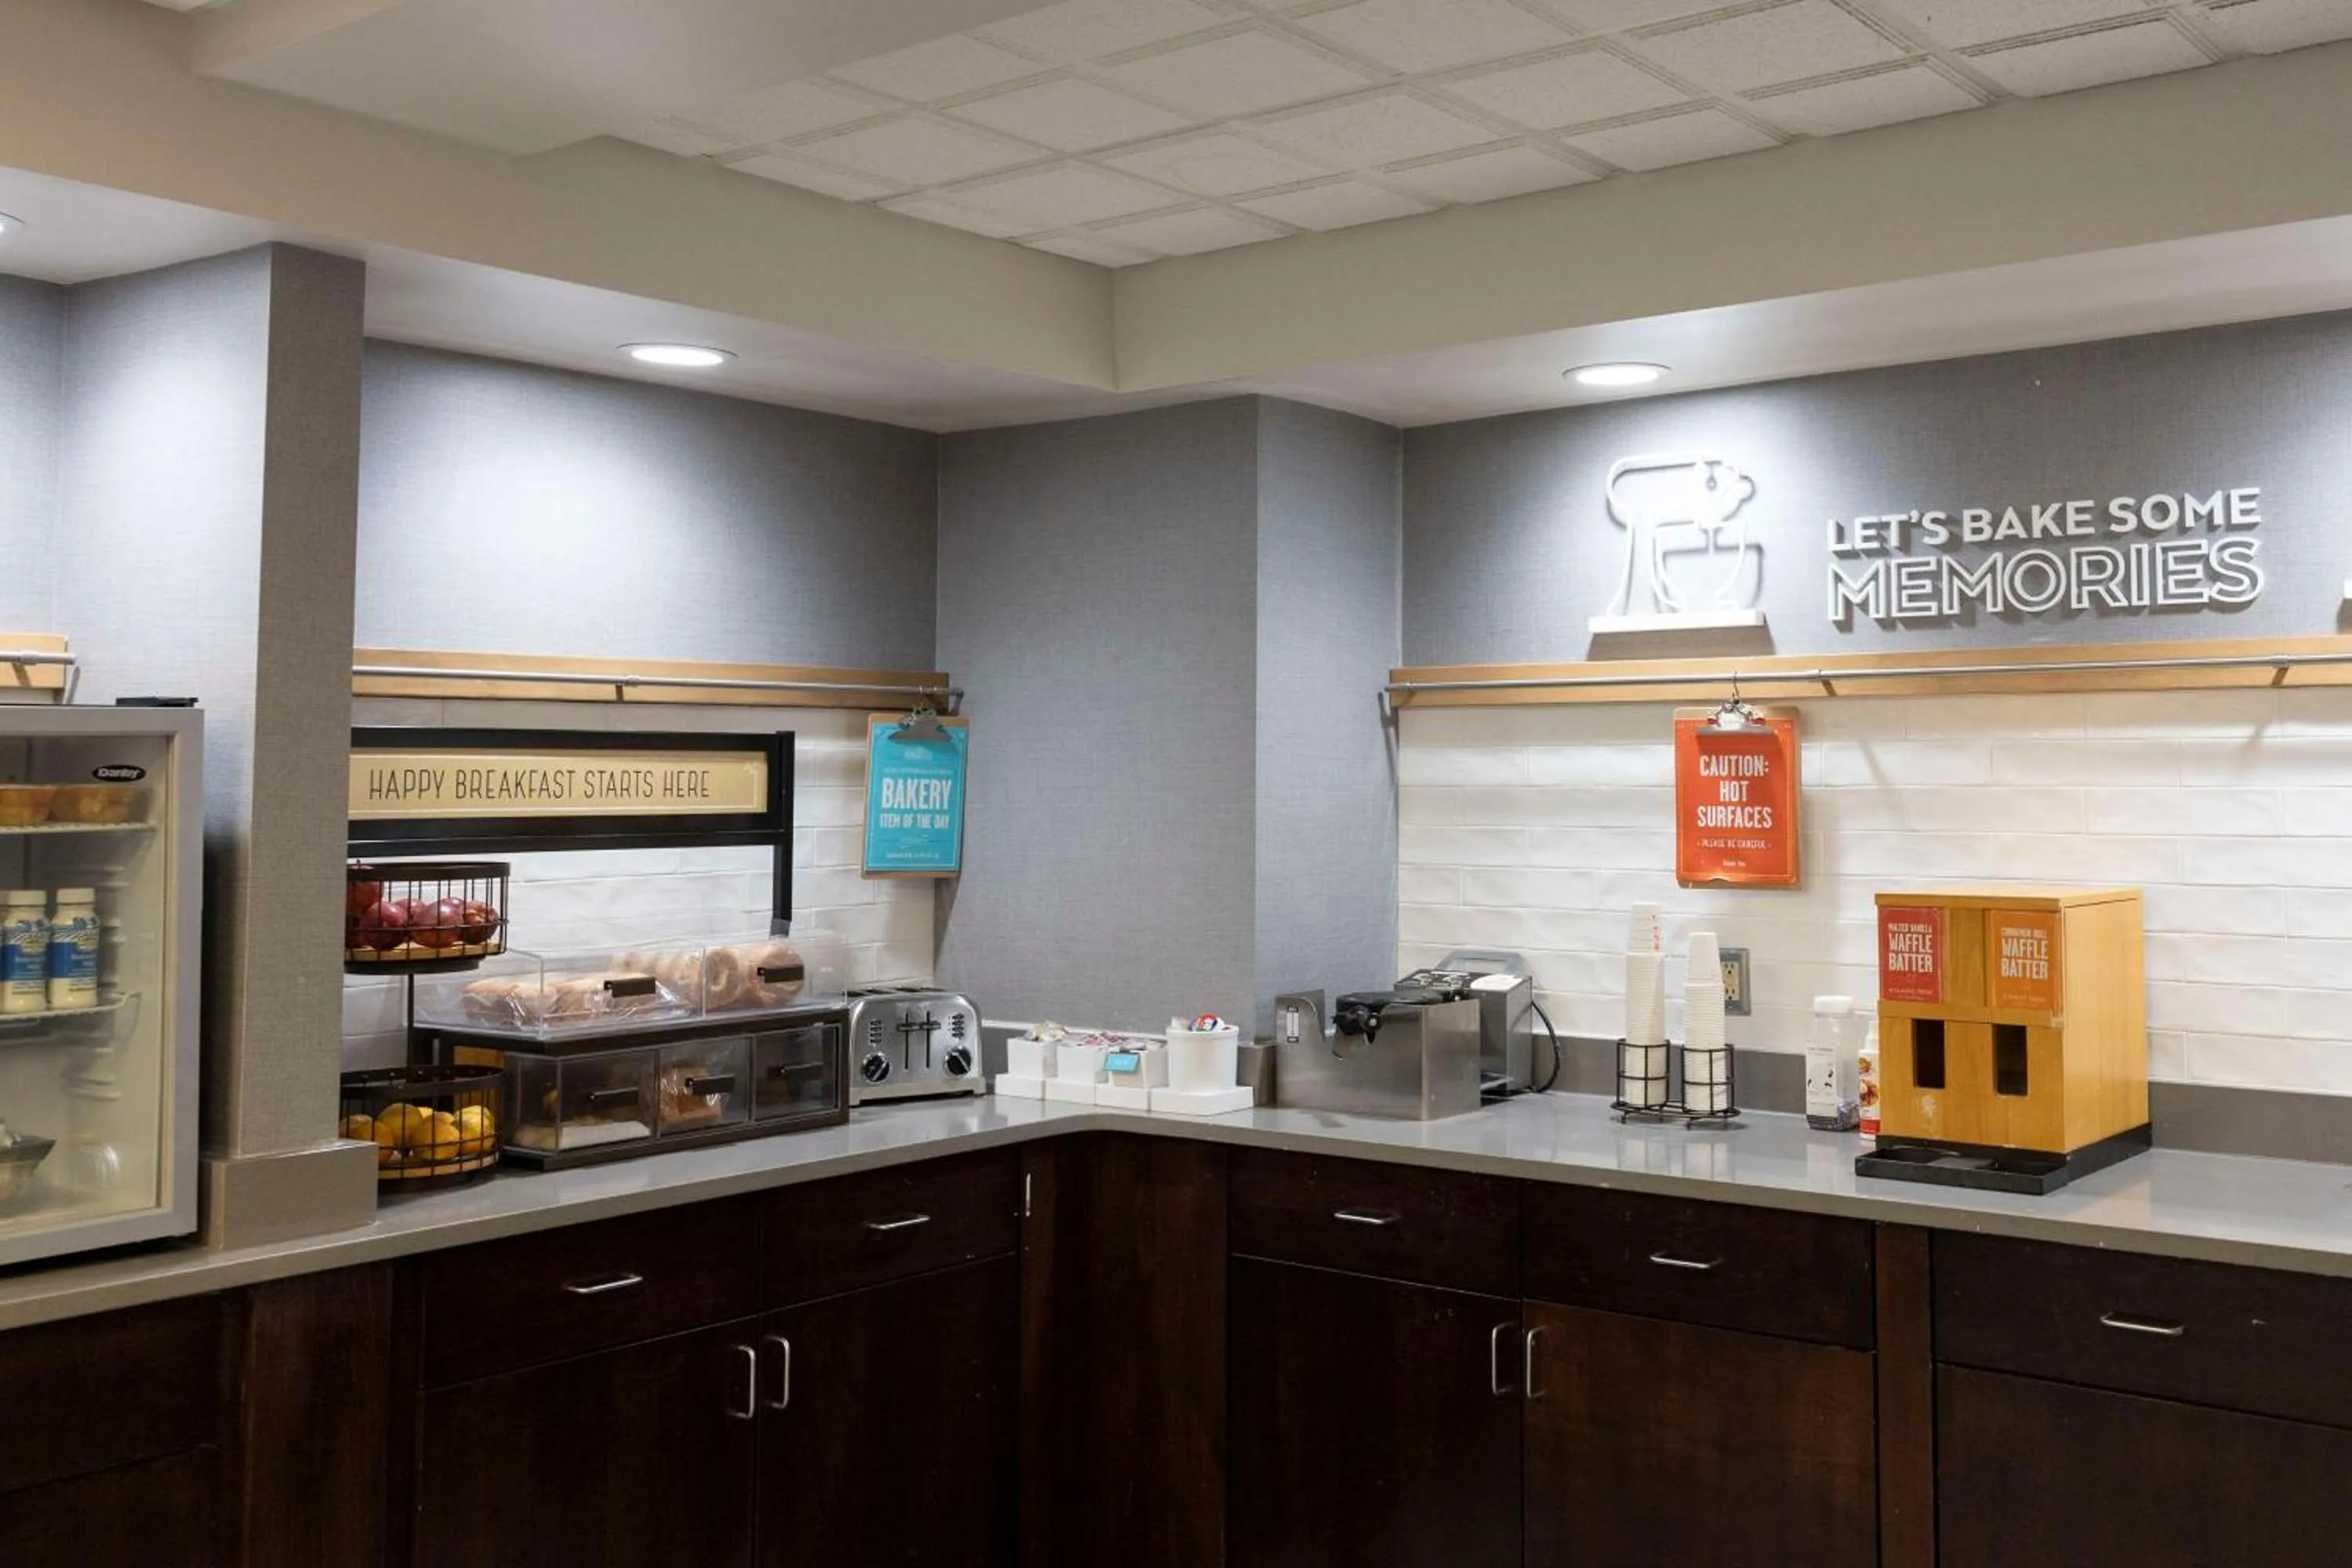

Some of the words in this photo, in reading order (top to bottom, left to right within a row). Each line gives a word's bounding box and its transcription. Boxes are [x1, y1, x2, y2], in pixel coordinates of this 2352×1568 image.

[1828, 510, 1948, 551] LET'S
[1962, 499, 2096, 543] BAKE
[2108, 487, 2262, 533] SOME
[1828, 536, 2265, 621] MEMORIES
[1700, 755, 1769, 777] CAUTION:
[369, 769, 445, 800] HAPPY
[455, 769, 577, 799] BREAKFAST
[583, 770, 654, 798] STARTS
[662, 770, 710, 798] HERE
[881, 777, 952, 810] BAKERY
[1719, 780, 1750, 801] HOT
[880, 813, 901, 828] ITEM
[902, 814, 913, 828] OF
[916, 814, 932, 829] THE
[1697, 805, 1773, 828] SURFACES
[1889, 932, 1933, 953] WAFFLE
[2002, 938, 2048, 960] WAFFLE
[1889, 953, 1933, 972] BATTER
[2001, 958, 2048, 979] BATTER
